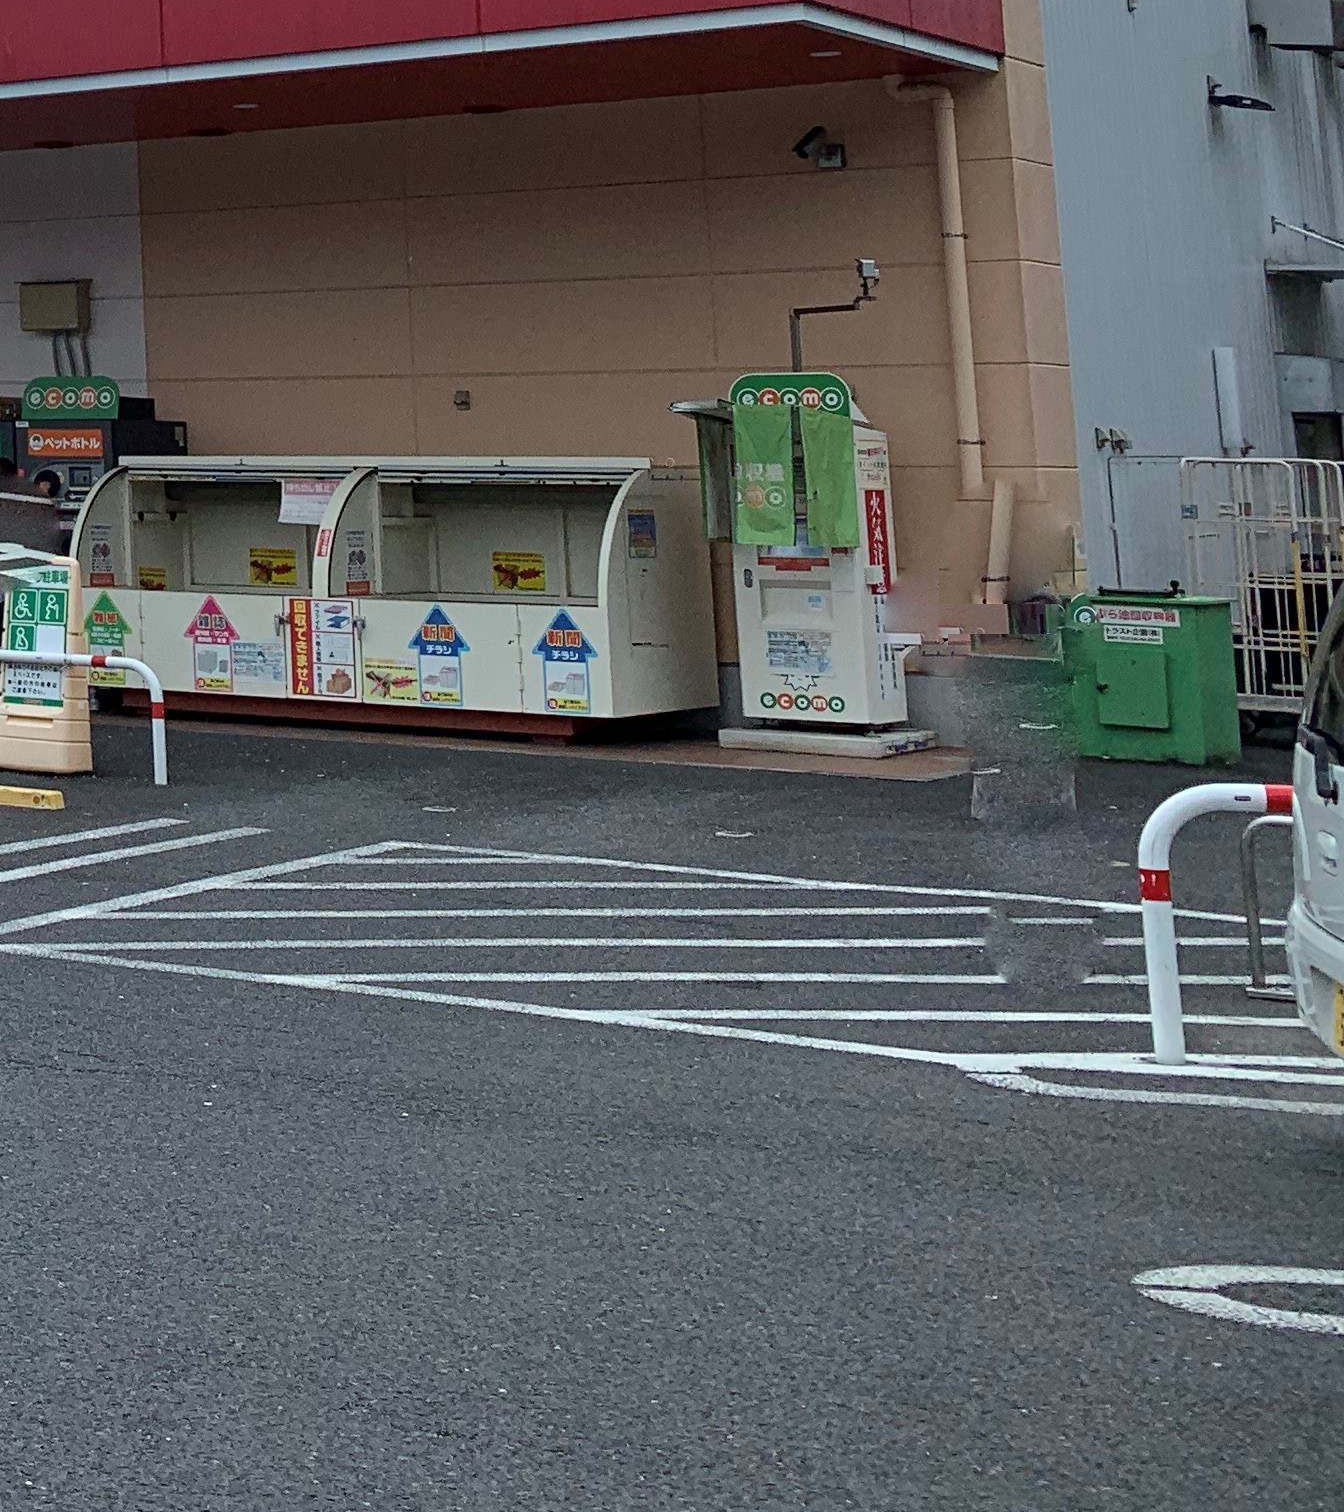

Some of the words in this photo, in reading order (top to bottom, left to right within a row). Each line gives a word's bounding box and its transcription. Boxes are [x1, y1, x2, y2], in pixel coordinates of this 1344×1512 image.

[28, 390, 112, 406] ecomo
[739, 390, 841, 408] ecomo
[44, 436, 100, 449] ペットボトル
[293, 600, 309, 694] 回収できません
[762, 693, 844, 711] ecomo
